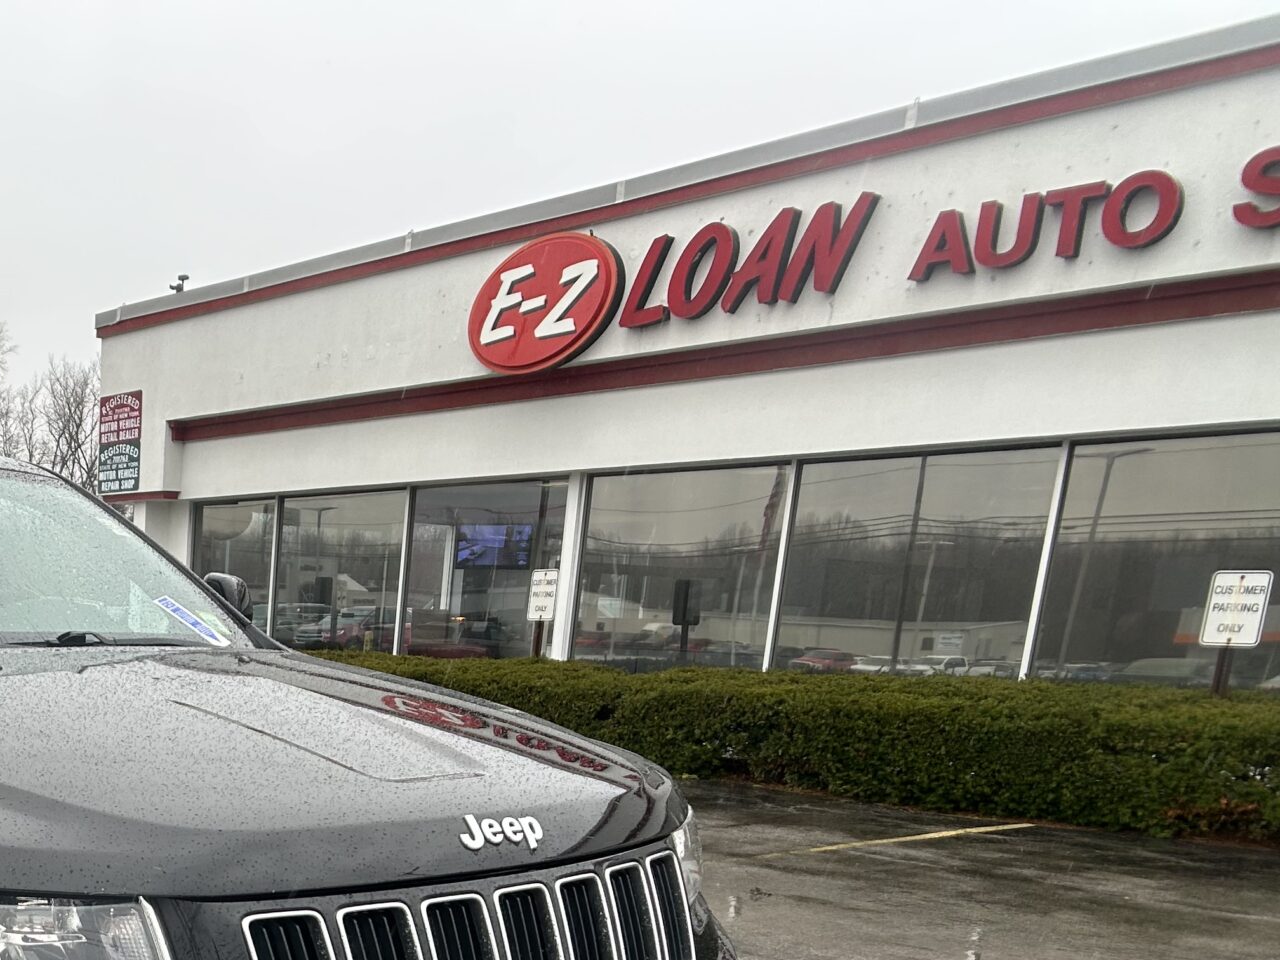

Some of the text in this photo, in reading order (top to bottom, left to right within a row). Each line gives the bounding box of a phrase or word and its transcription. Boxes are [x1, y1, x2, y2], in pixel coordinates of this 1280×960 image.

[478, 257, 600, 347] E-Z
[617, 190, 882, 328] LOAN
[908, 168, 1186, 282] AUTO
[101, 394, 140, 415] REGISTERED
[100, 417, 140, 433] MOTOR VEHICLE
[101, 428, 139, 444] RETAIL DEALER
[100, 444, 139, 463] REGISTERED
[99, 466, 138, 481] MOTOR VEHICLE
[101, 479, 135, 491] REPAIR SHOP
[1214, 585, 1267, 595] CUSTOMER
[1212, 602, 1260, 612] PARKING
[1216, 623, 1245, 633] ONLY
[459, 813, 544, 852] Jeep
